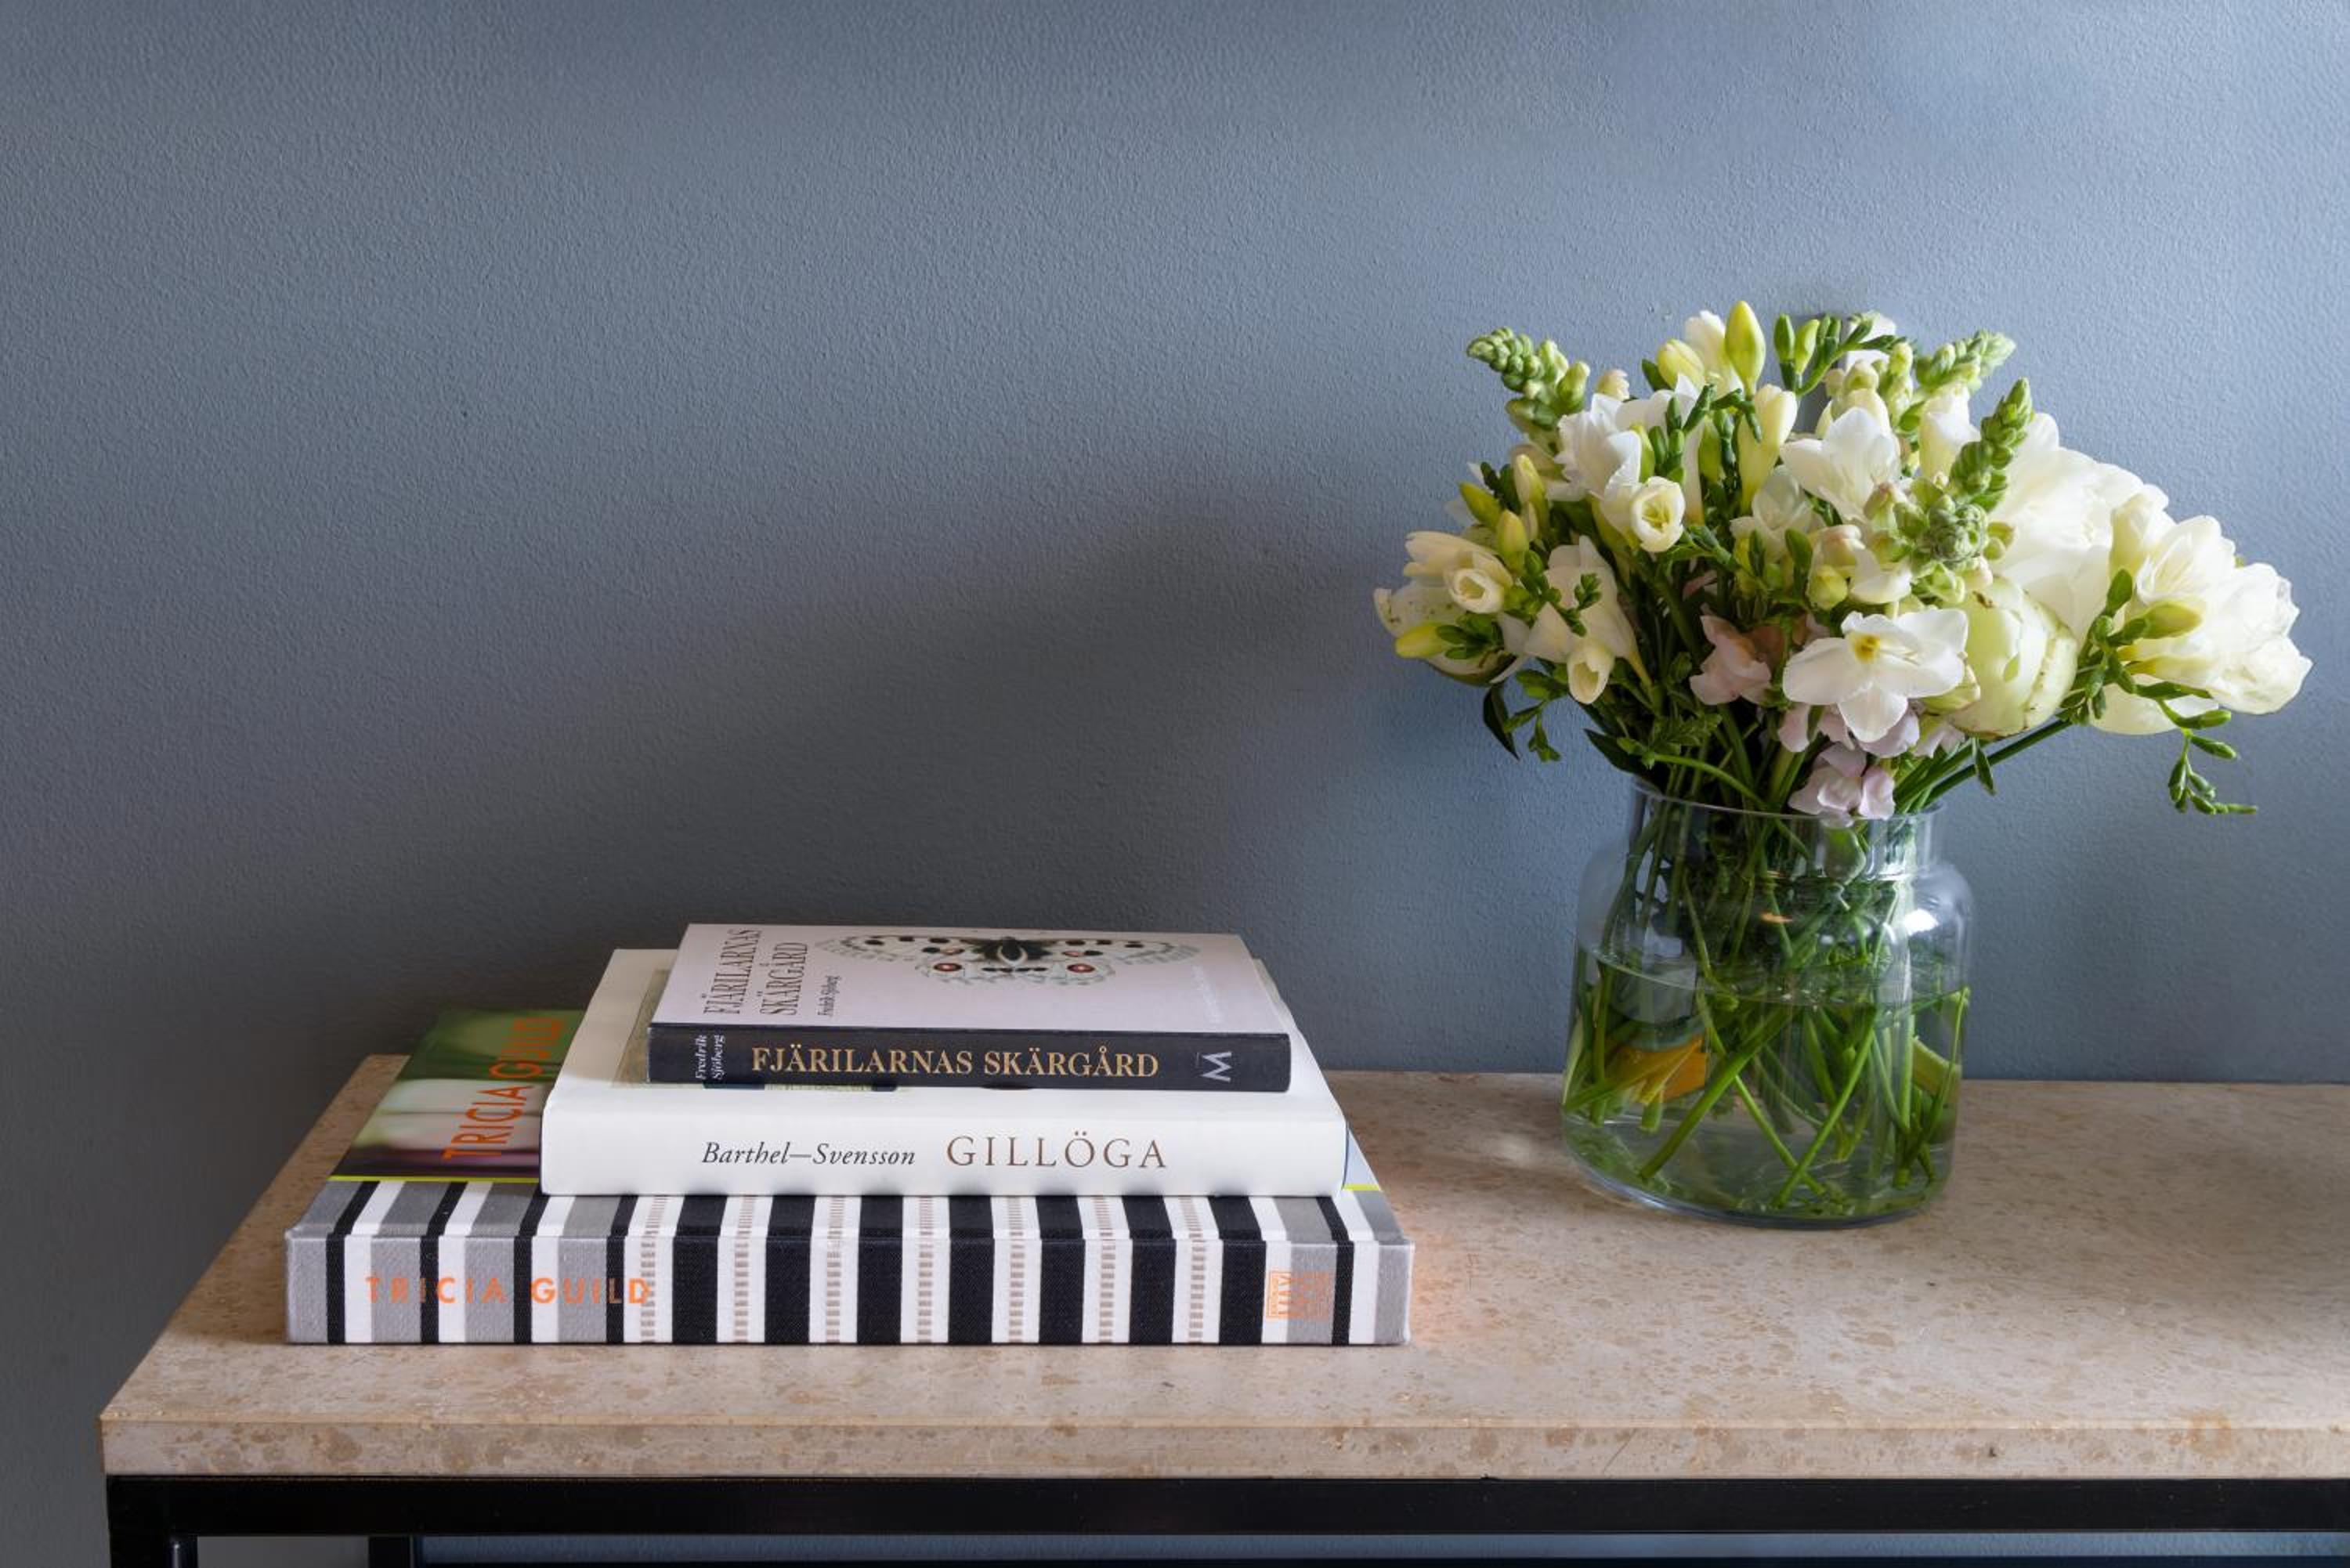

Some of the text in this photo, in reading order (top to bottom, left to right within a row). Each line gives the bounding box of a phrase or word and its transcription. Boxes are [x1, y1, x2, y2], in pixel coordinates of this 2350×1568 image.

[702, 929, 762, 1014] FJÄRILARNAS
[757, 941, 808, 1015] SKÄRGÅRD
[695, 1035, 707, 1080] Fredrik
[711, 1035, 725, 1080] Sjöberg
[751, 1043, 1159, 1078] FJÄRILARNAS SKÄRGÅRD
[440, 1016, 565, 1161] TRICIA GUILD
[946, 1130, 1166, 1168] GILLÖGA
[365, 1277, 651, 1305] TRICIA GUILD
